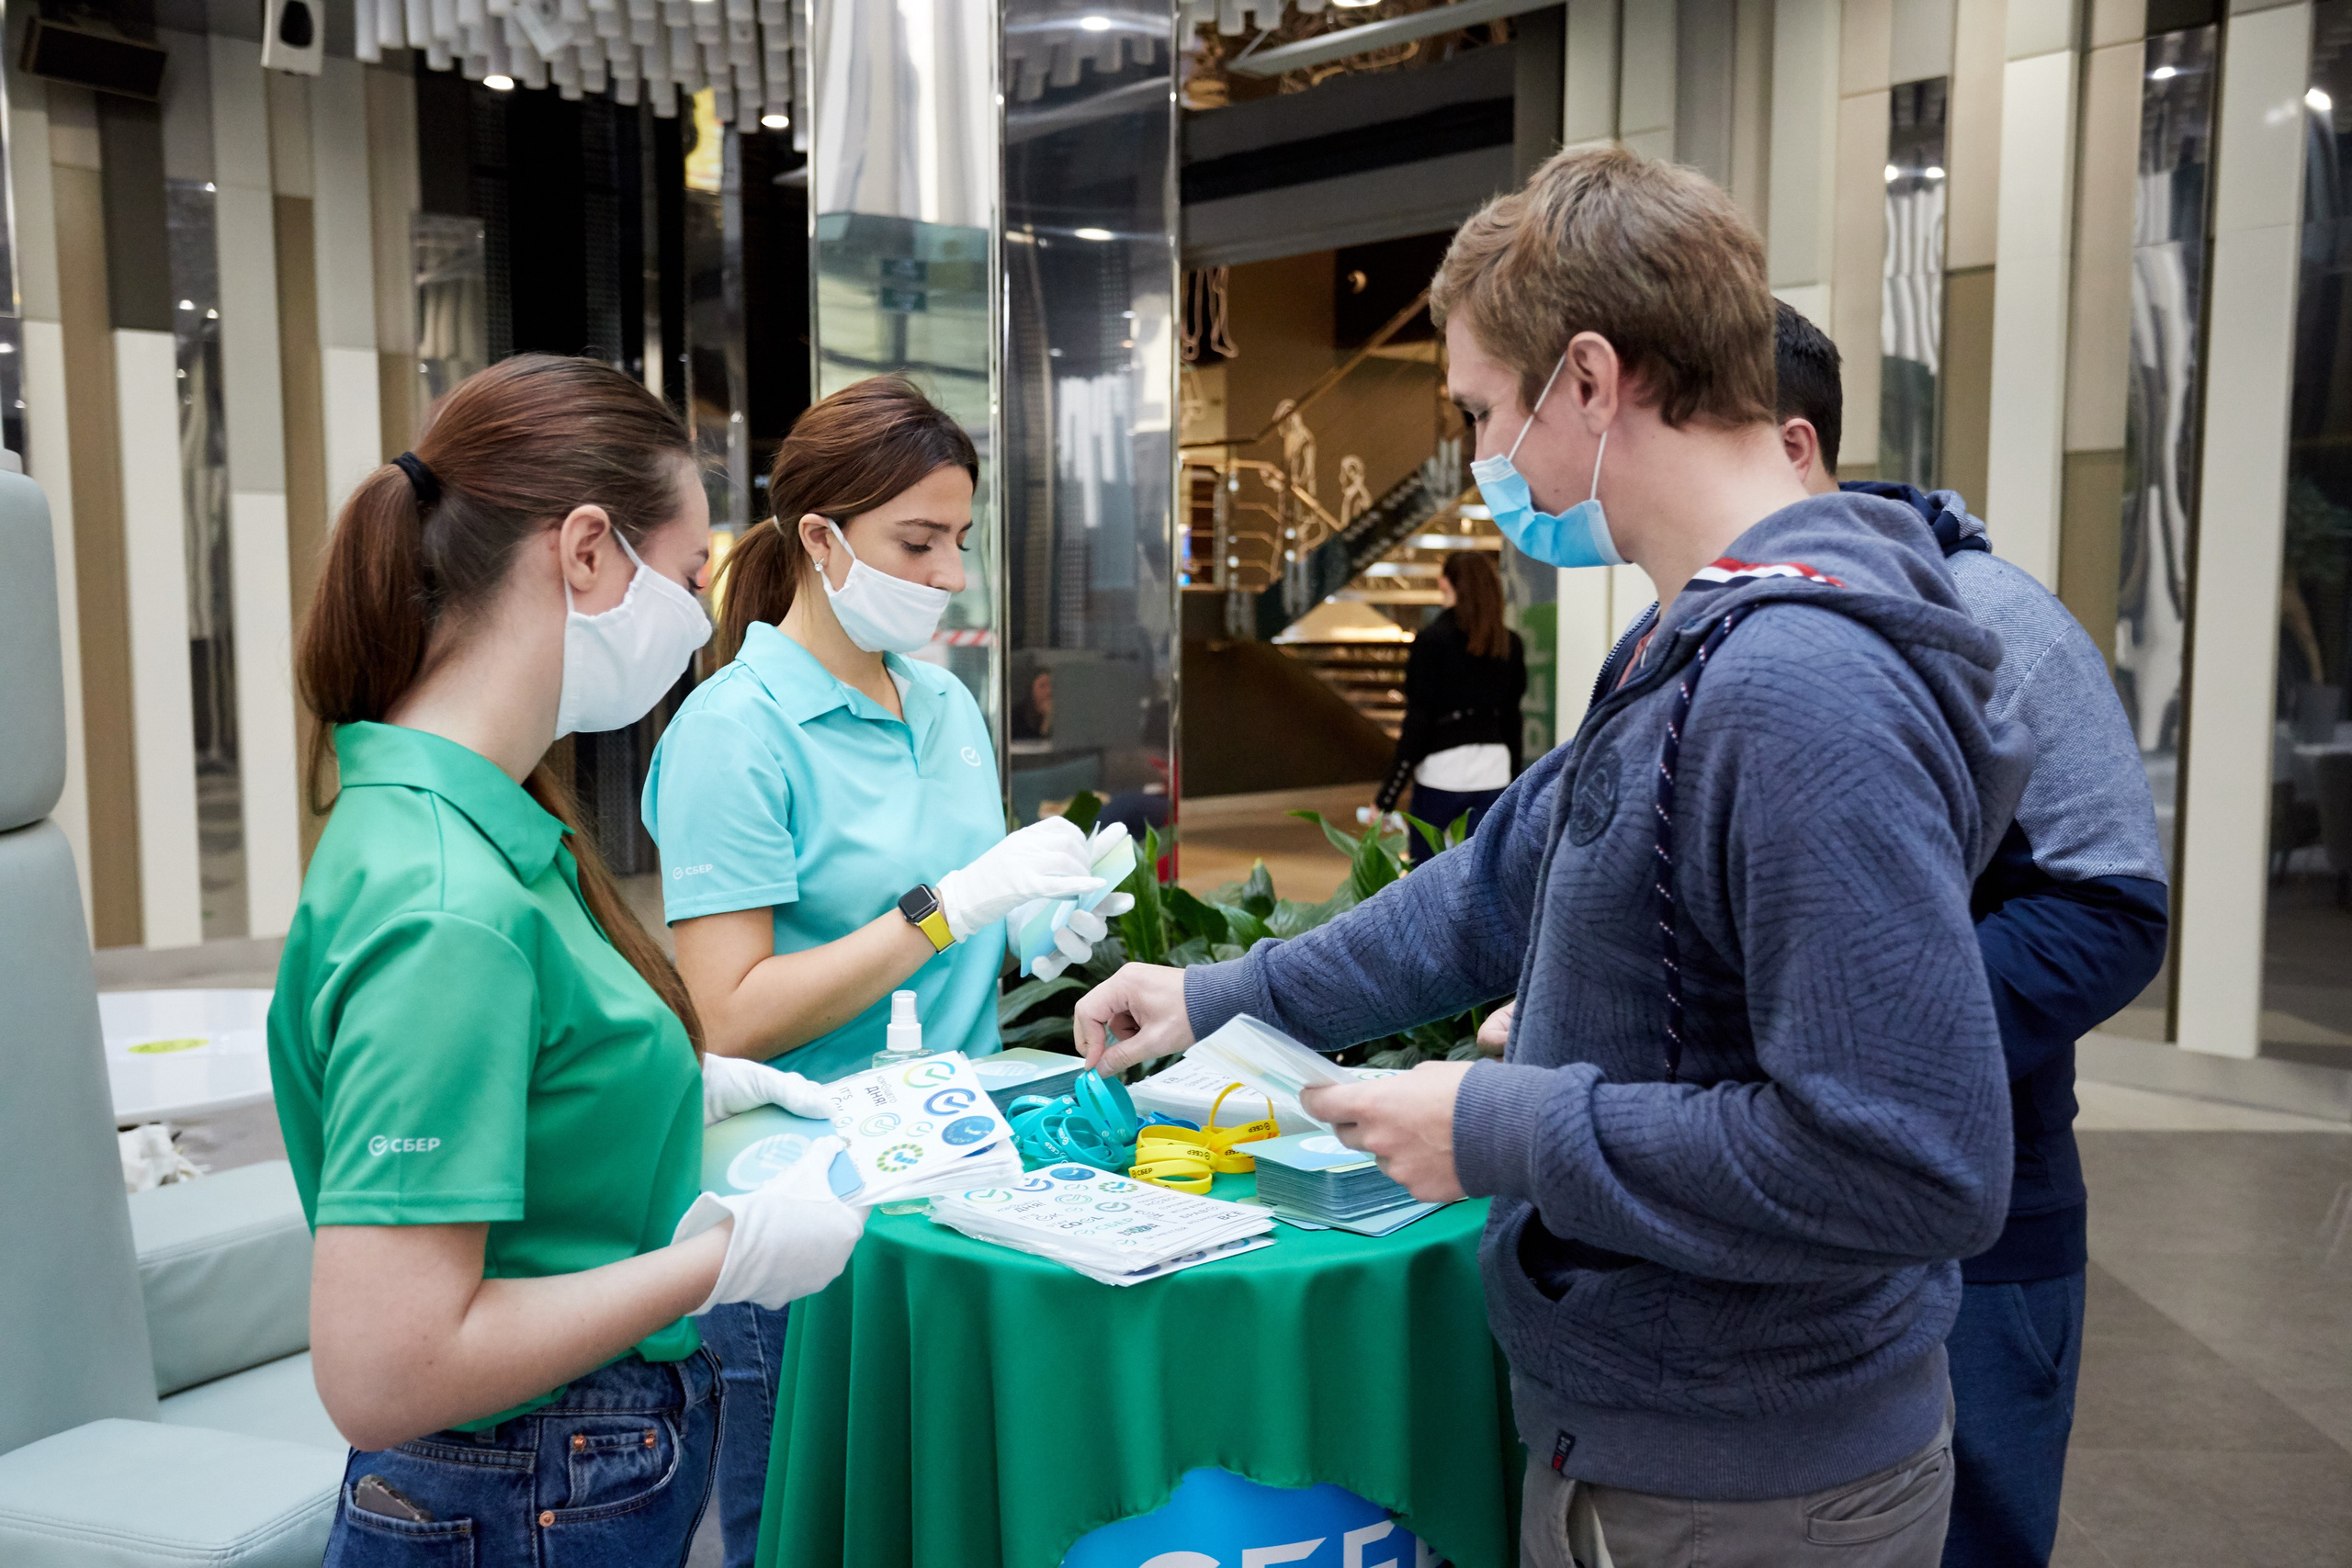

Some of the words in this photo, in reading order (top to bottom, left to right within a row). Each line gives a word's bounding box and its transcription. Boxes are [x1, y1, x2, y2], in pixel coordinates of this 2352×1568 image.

[684, 863, 714, 875] СБЕР
[839, 1087, 854, 1100] IT'S
[864, 1086, 888, 1107] ДНЯ!
[1248, 1124, 1264, 1134] СБЕР
[390, 1137, 441, 1153] СБЕР
[1045, 1142, 1059, 1155] СБЕР
[1187, 1149, 1204, 1157] СБЕР
[1136, 1168, 1153, 1176] СБЕР
[1014, 1201, 1046, 1213] ДНЯ!
[1217, 1210, 1246, 1222] ВСЕ
[1095, 1217, 1134, 1231] СБЕР
